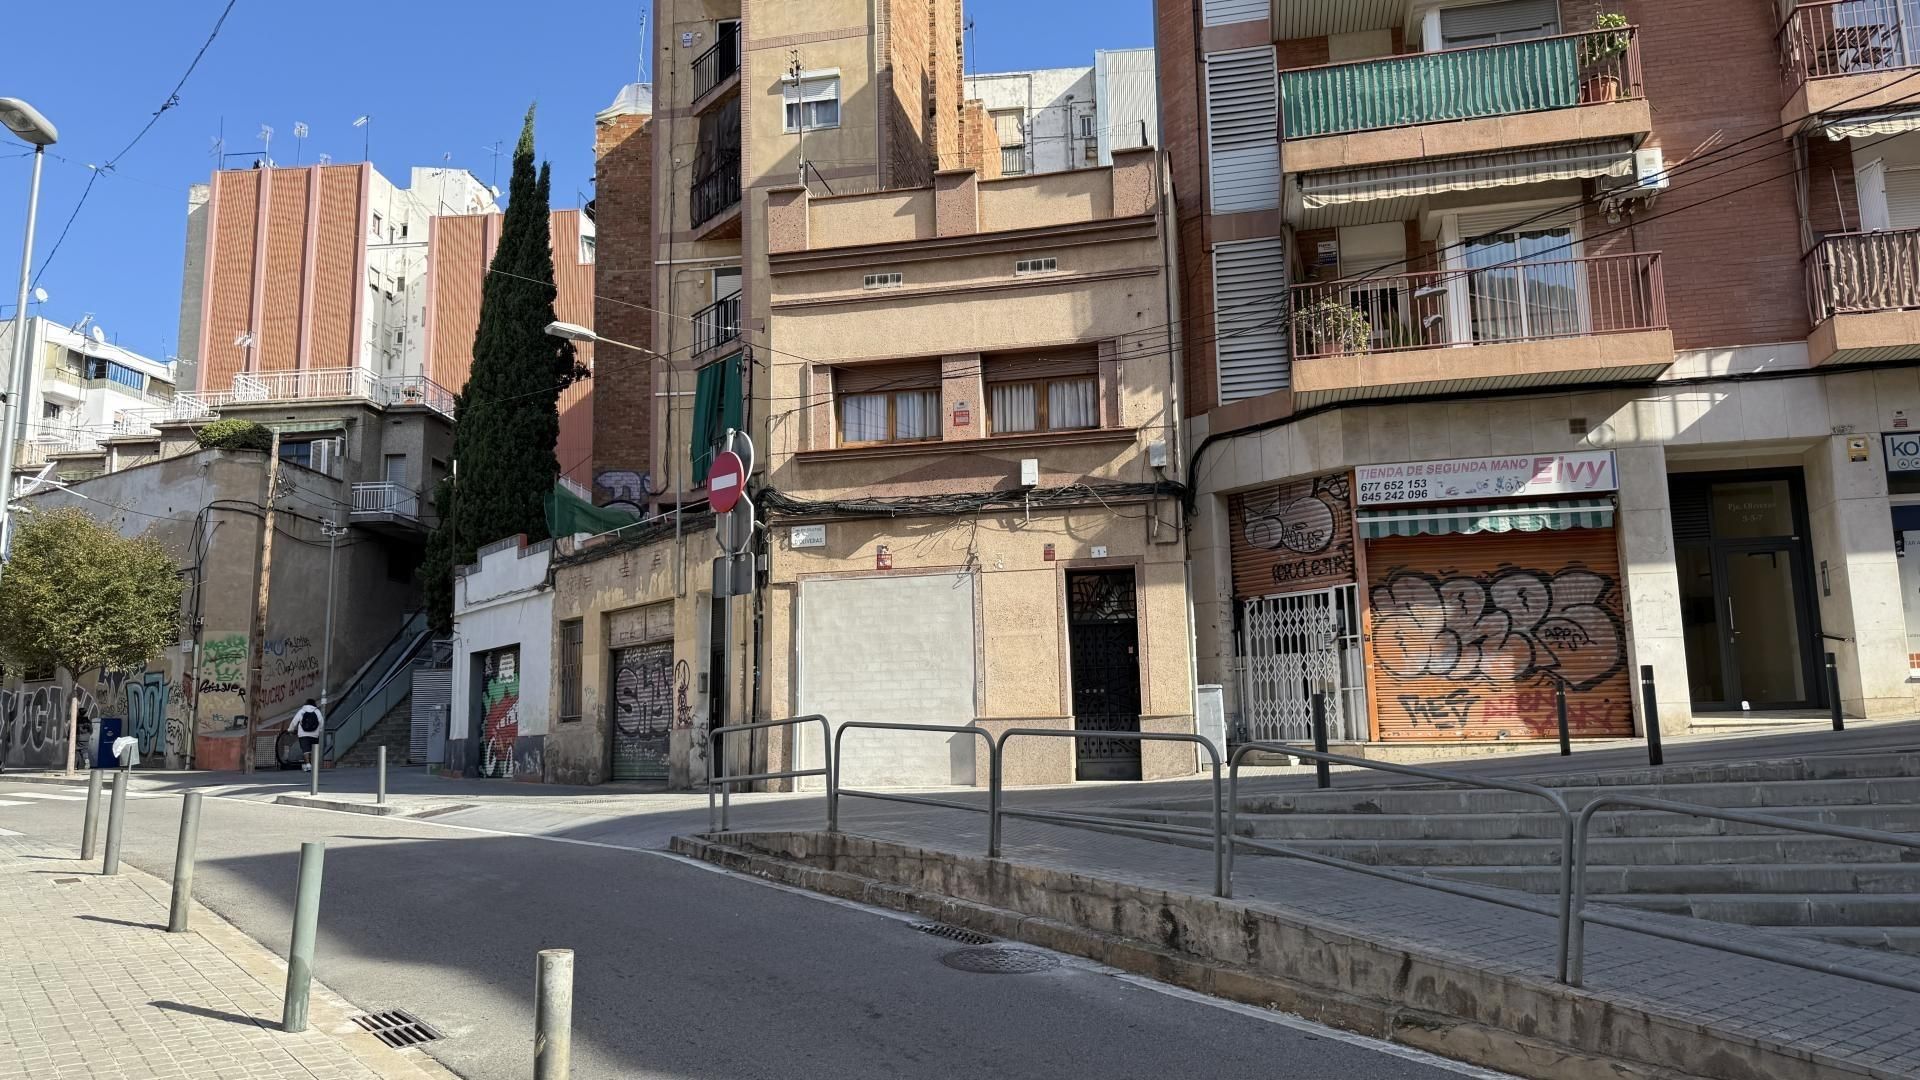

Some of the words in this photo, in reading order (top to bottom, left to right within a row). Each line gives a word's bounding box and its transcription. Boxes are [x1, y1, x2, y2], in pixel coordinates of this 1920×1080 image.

[1890, 436, 1920, 457] ko
[1359, 467, 1404, 479] TIENDA
[1407, 465, 1423, 476] DE
[1426, 461, 1488, 474] SEGUNDA
[1491, 458, 1529, 471] MANO
[1361, 482, 1380, 492] 677
[1384, 480, 1404, 490] 652
[1408, 479, 1427, 489] 153
[1361, 492, 1381, 501] 645
[1385, 490, 1404, 500] 242
[1408, 489, 1428, 499] 096
